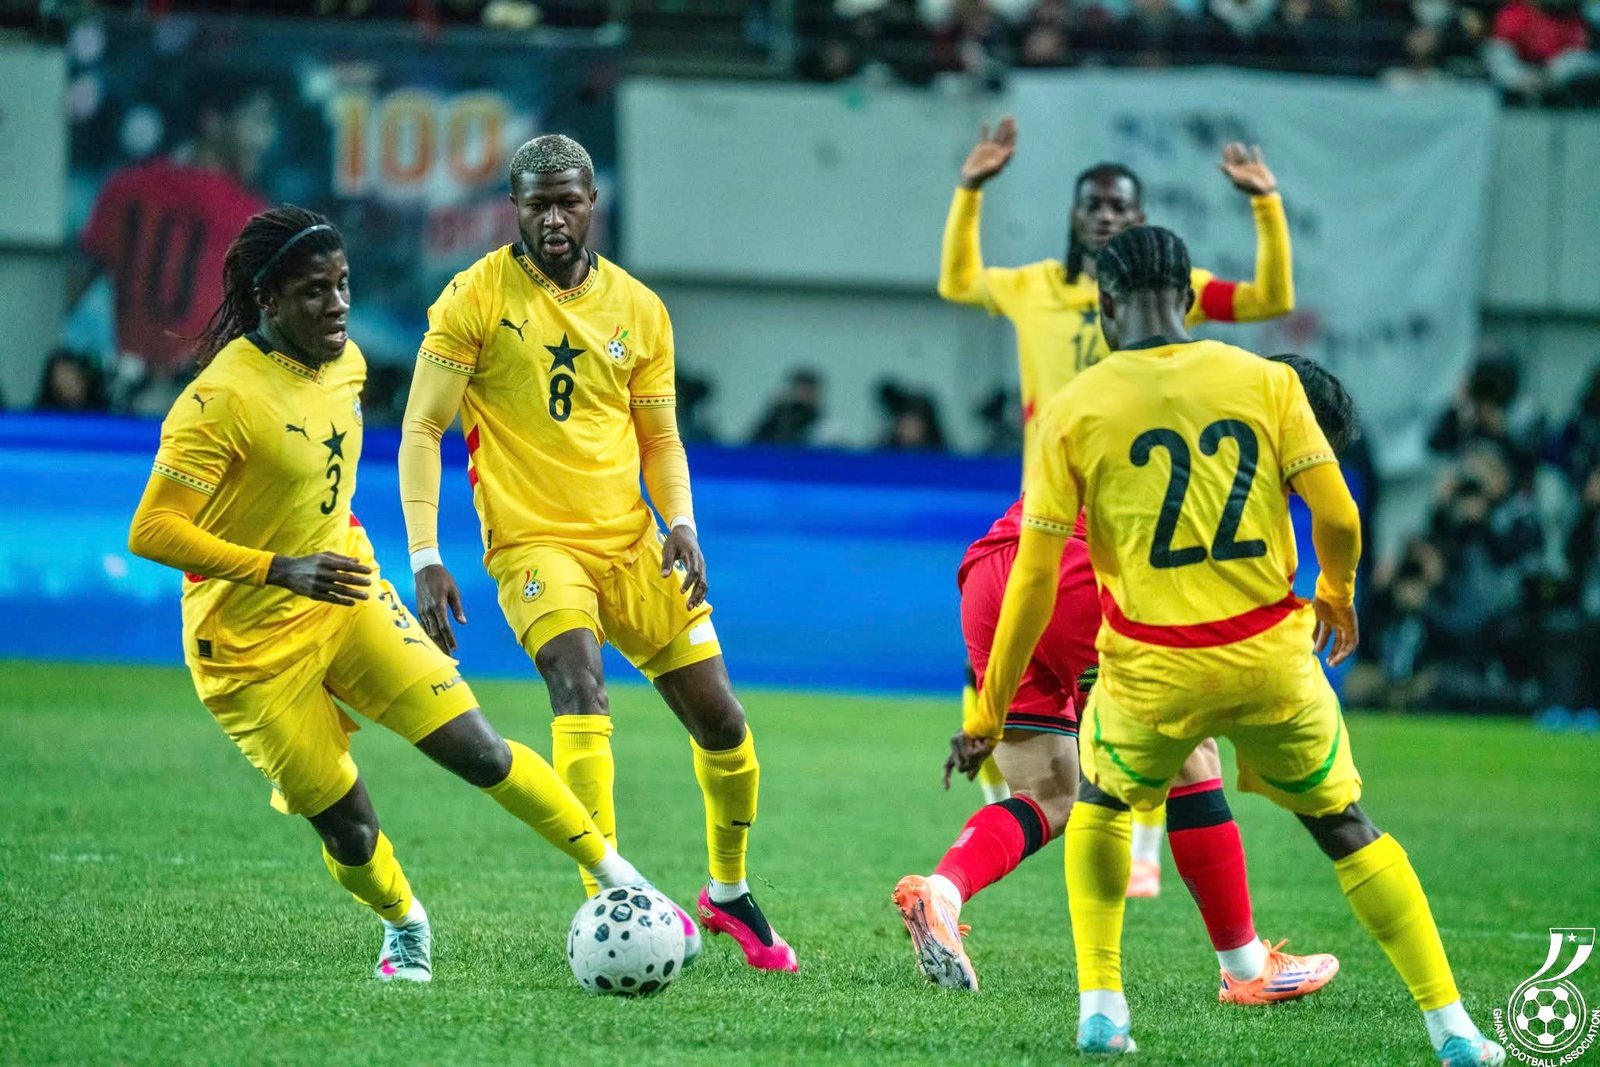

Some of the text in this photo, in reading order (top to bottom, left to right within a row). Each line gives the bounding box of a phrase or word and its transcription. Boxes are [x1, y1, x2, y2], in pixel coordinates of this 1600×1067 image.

[335, 88, 507, 188] 100
[115, 199, 211, 326] 10
[549, 373, 575, 422] 8
[320, 463, 342, 515] 3
[1129, 418, 1267, 569] 22
